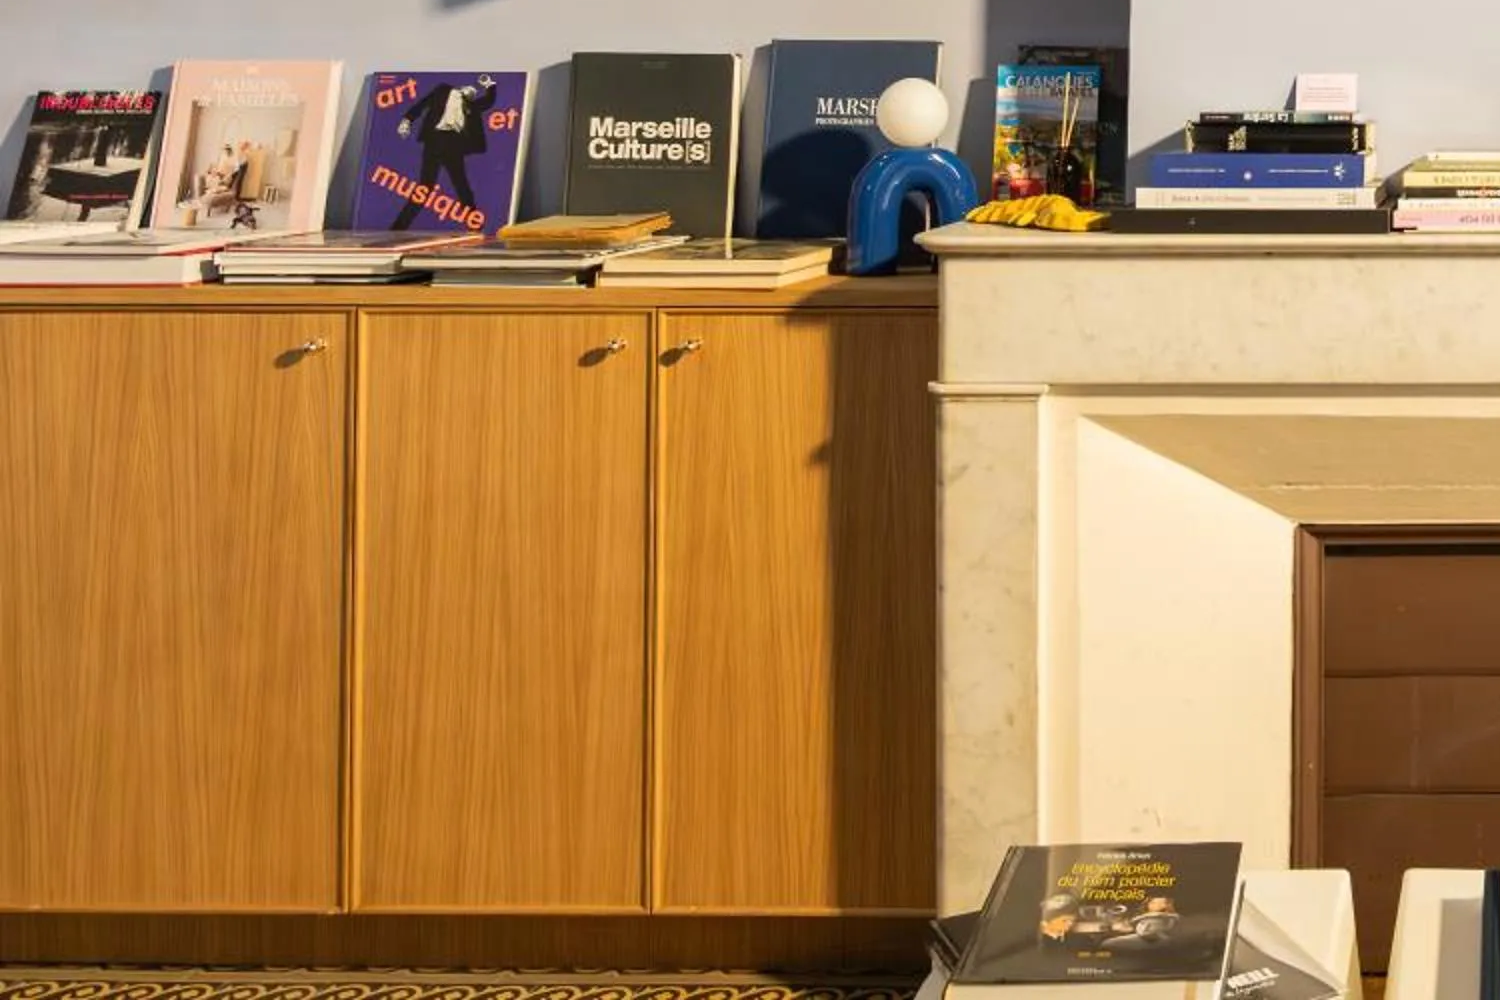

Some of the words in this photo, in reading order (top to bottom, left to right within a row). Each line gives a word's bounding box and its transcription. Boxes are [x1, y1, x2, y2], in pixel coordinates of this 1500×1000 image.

[376, 77, 418, 109] art
[488, 107, 520, 131] et
[589, 116, 712, 139] Marseille
[588, 137, 711, 164] Culture[s]
[371, 164, 486, 230] musique
[1057, 875, 1079, 887] du
